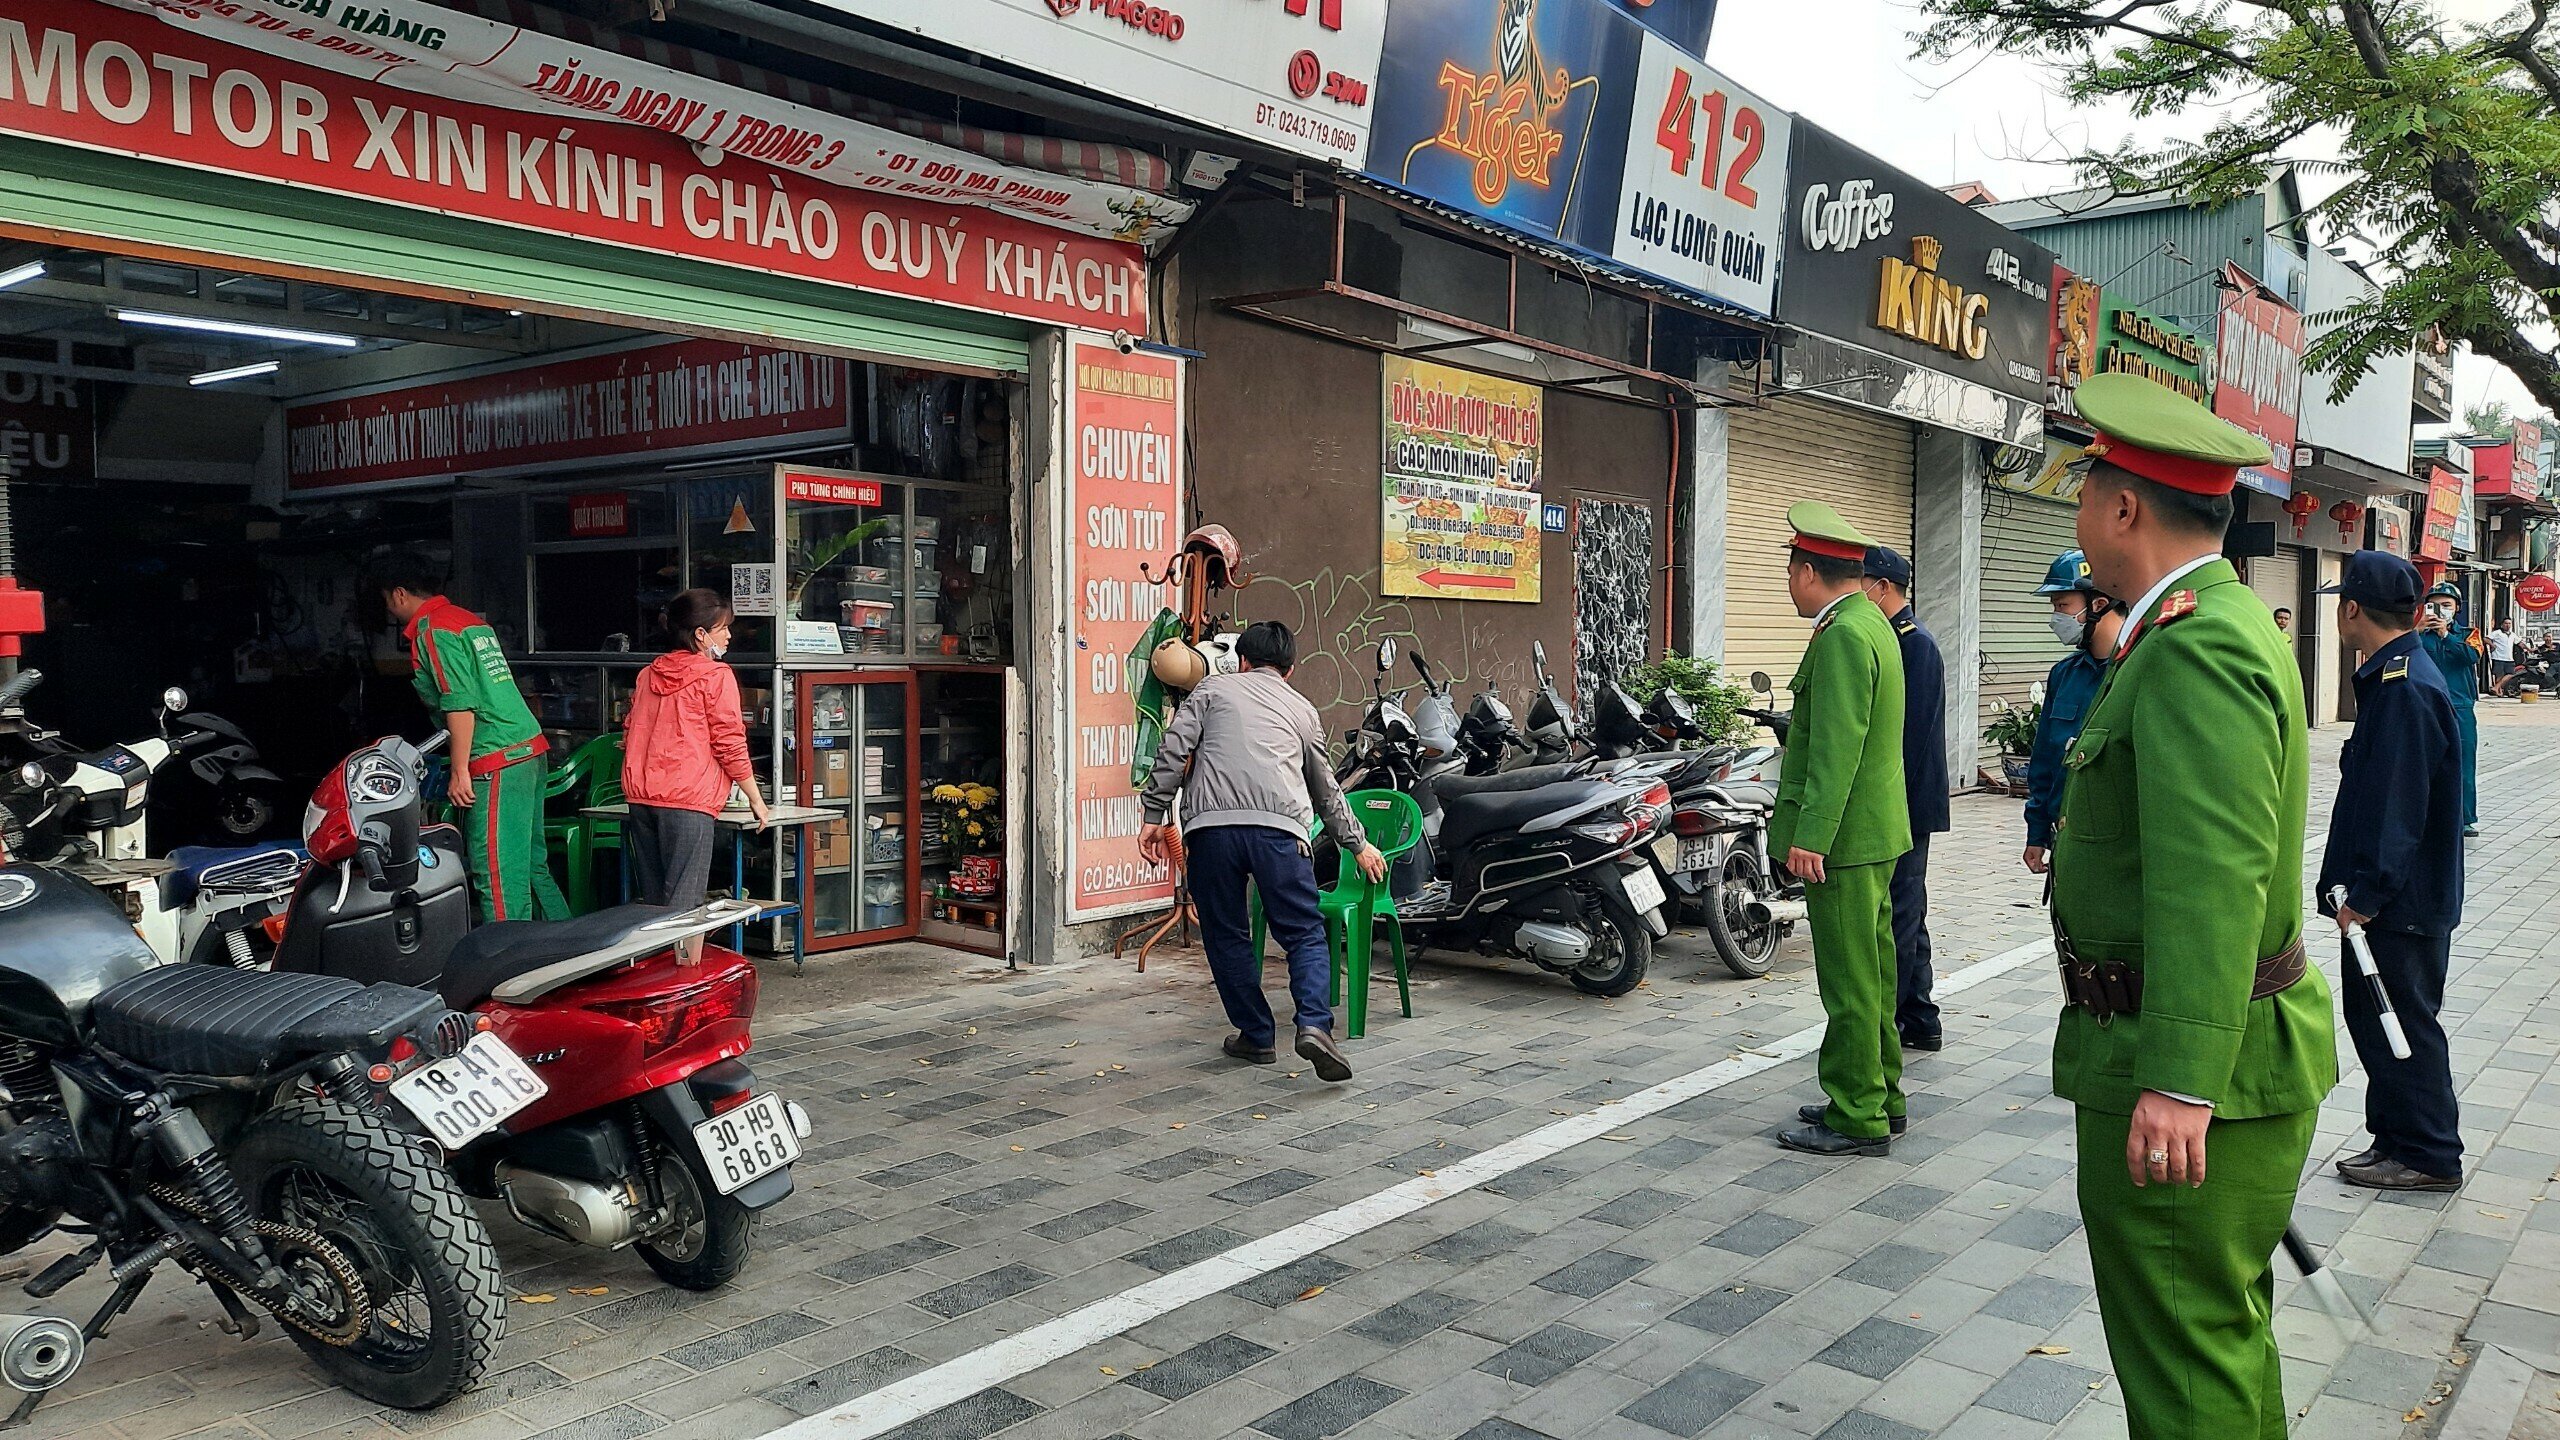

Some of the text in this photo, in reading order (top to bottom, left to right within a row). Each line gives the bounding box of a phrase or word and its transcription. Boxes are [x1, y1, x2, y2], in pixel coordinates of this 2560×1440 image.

[338, 5, 447, 51] HÀNG
[1321, 70, 1369, 108] SYM
[726, 114, 819, 170] TRONG
[808, 140, 847, 170] 3
[1256, 102, 1357, 153] ĐT: 0243.719.0609
[1437, 60, 1564, 204] Tiger
[1655, 66, 1765, 209] 412
[0, 17, 1130, 318] MOTOR XIN KÍNH CHÀO QUÝ KHÁCH
[887, 153, 920, 174] 01
[920, 160, 961, 184] ĐÔI
[962, 172, 1004, 193] MÁ
[1000, 181, 1072, 208] PHANH
[1630, 191, 1766, 285] LẠC LONG QUÂN
[1801, 179, 1894, 253] Coffee
[1985, 247, 2020, 281] 412
[1876, 256, 1991, 361] KING
[573, 383, 593, 440] XE
[598, 358, 627, 437] THẾ
[631, 361, 653, 445] HỆ
[657, 356, 692, 429] MỚI
[696, 365, 713, 424] FI
[1393, 378, 1538, 447] ĐẶC SẢN RƯƠI PHỐ CỔ
[1082, 422, 1172, 485] CHUYÊN
[1398, 436, 1427, 471] CÁC
[1428, 441, 1460, 476] MÓN
[1463, 448, 1497, 486] NHẬU
[1510, 450, 1533, 485] LẨU
[791, 480, 876, 505] PHỤ TÙNG CHÍNH HIỆU
[1087, 502, 1167, 551] SƠN TÚT
[1546, 509, 1563, 528] 414
[1419, 543, 1434, 561] ĐC:
[1436, 545, 1451, 562] 416
[1471, 548, 1491, 566] Long
[1086, 576, 1126, 622] SƠN
[1092, 643, 1118, 695] GÒ
[1082, 725, 1116, 767] THAY
[1107, 795, 1142, 839] KHUNG
[1083, 860, 1102, 893] CÓ
[1105, 858, 1133, 890] BẢO
[1682, 851, 1714, 871] 5634
[414, 1044, 501, 1103] 18-A1
[709, 1103, 774, 1153] 30-H9
[723, 1133, 788, 1183] 6868
